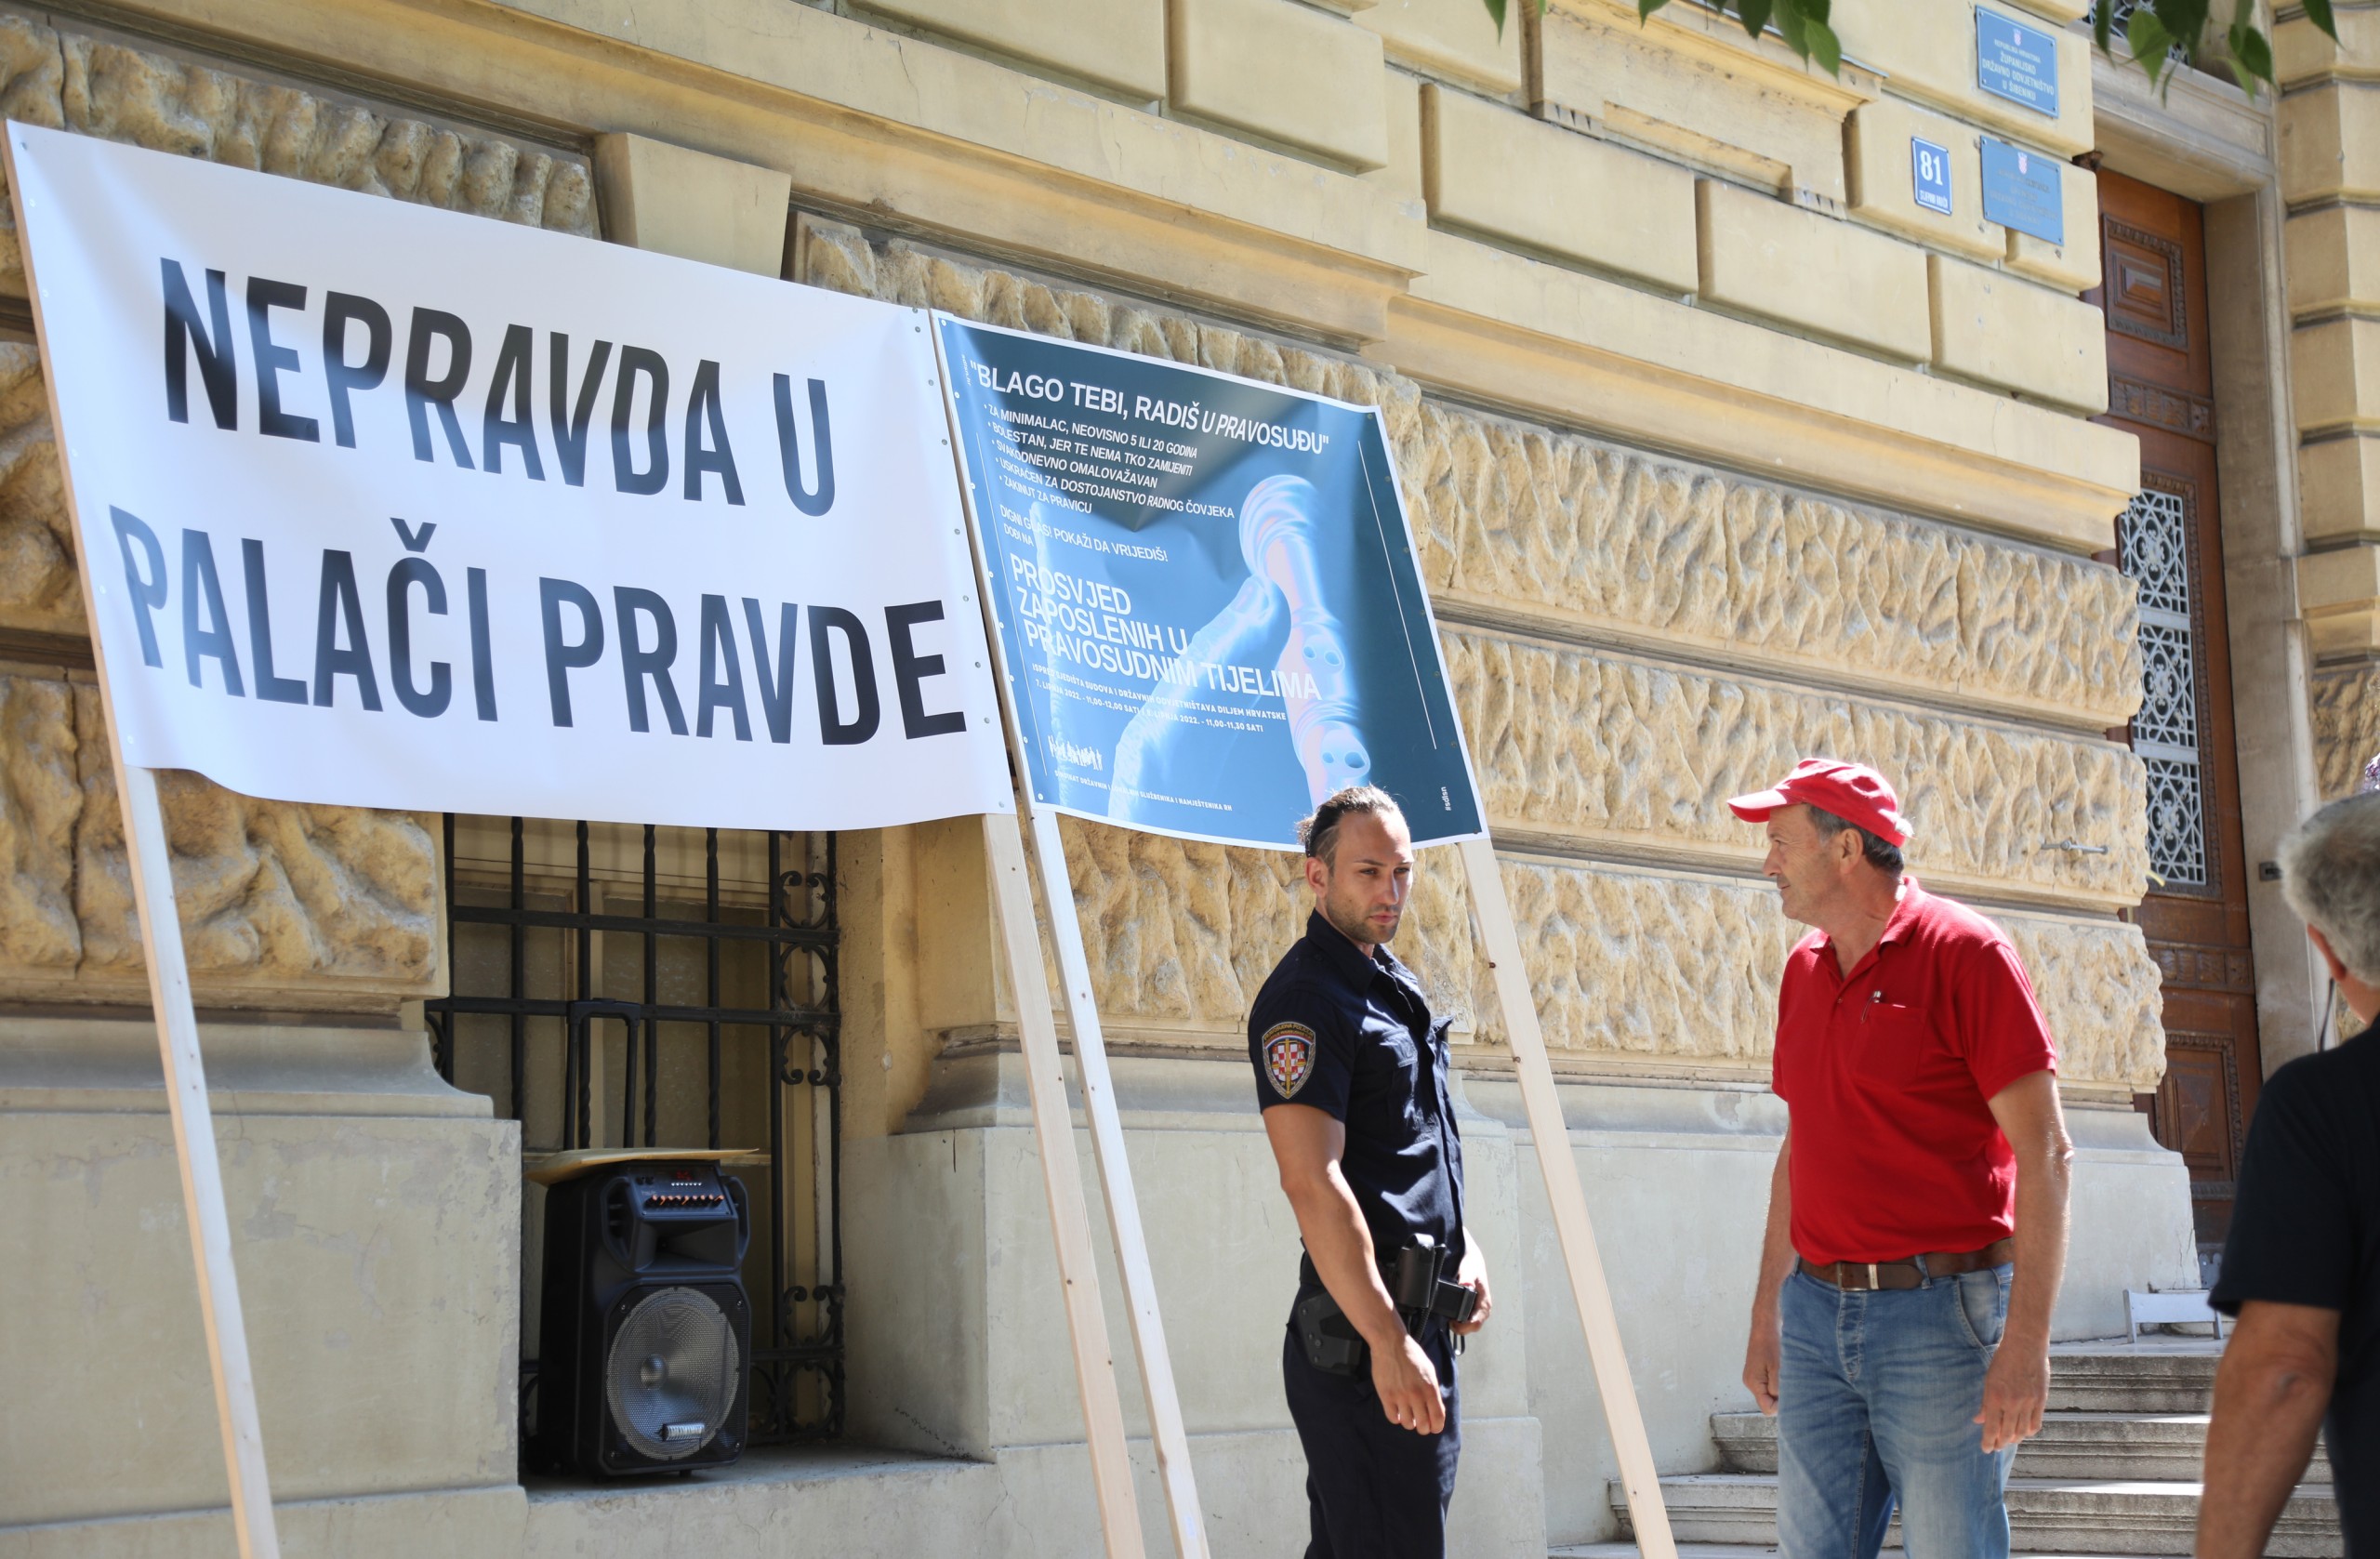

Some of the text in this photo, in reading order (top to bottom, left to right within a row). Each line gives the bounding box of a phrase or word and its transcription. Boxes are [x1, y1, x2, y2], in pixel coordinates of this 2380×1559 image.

[1981, 58, 2054, 96] DRŽAVNO ODVJETNIŠTVO
[2003, 80, 2036, 101] U ŠIBENIKU
[1920, 150, 1943, 186] 81
[161, 258, 836, 517] NEPRAVDA U
[970, 360, 1329, 455] "BLAGO TEBI, RADIŠ U PRAVOSUĐU"
[989, 403, 1197, 459] ZA MINIMALAC, NEOVISNO 5 ILI 20 GODINA
[992, 422, 1194, 477] BOLESTAN, JER TE NEMA TKO ZAMIJENITI
[996, 440, 1158, 489] SVAKODNEVNO OMALOVAŽAVAN
[999, 457, 1236, 519] USKRAĆEN ZA DOSTOJANSTVO RADNOG ČOVJEKA
[1002, 474, 1092, 514] ZAKINUT ZA PRAVICU
[999, 504, 1169, 562] DIGNI GLAS! POKAŽI DA VRIJEDIŠ!
[1003, 522, 1035, 548] DOĐI NA
[1010, 552, 1131, 615] PROSVJED
[109, 504, 967, 746] PALAČI PRAVDE
[1016, 586, 1188, 655] ZAPOSLENIH U
[1024, 619, 1324, 701] PRAVOSUDNIM TIJELIMA
[1032, 663, 1056, 678] ISPRED
[1056, 671, 1084, 688] SJEDIŠTA
[1084, 680, 1114, 695] SUDOVA
[1118, 689, 1154, 704] DRŽAVNIH
[1156, 695, 1217, 713] ODVJETNIŠTAVA
[1217, 705, 1245, 717] DILJEM
[1246, 708, 1287, 721] HRVATSKE
[1035, 679, 1041, 688] 7.
[1042, 680, 1064, 694] LIPNJA
[1064, 689, 1081, 702] 2022.
[1123, 704, 1141, 715] SATI
[1154, 710, 1179, 721] LIPNJA
[1180, 715, 1200, 725] 2022.
[1206, 719, 1245, 732] 11,00-11,30
[1246, 723, 1264, 733] SATI
[1054, 770, 1079, 784] SINDIKAT
[1079, 776, 1108, 790] DRŽAVNIH
[1139, 790, 1175, 804] SLUŽBENIKA
[1179, 797, 1223, 811] NAMJEŠTENIKA
